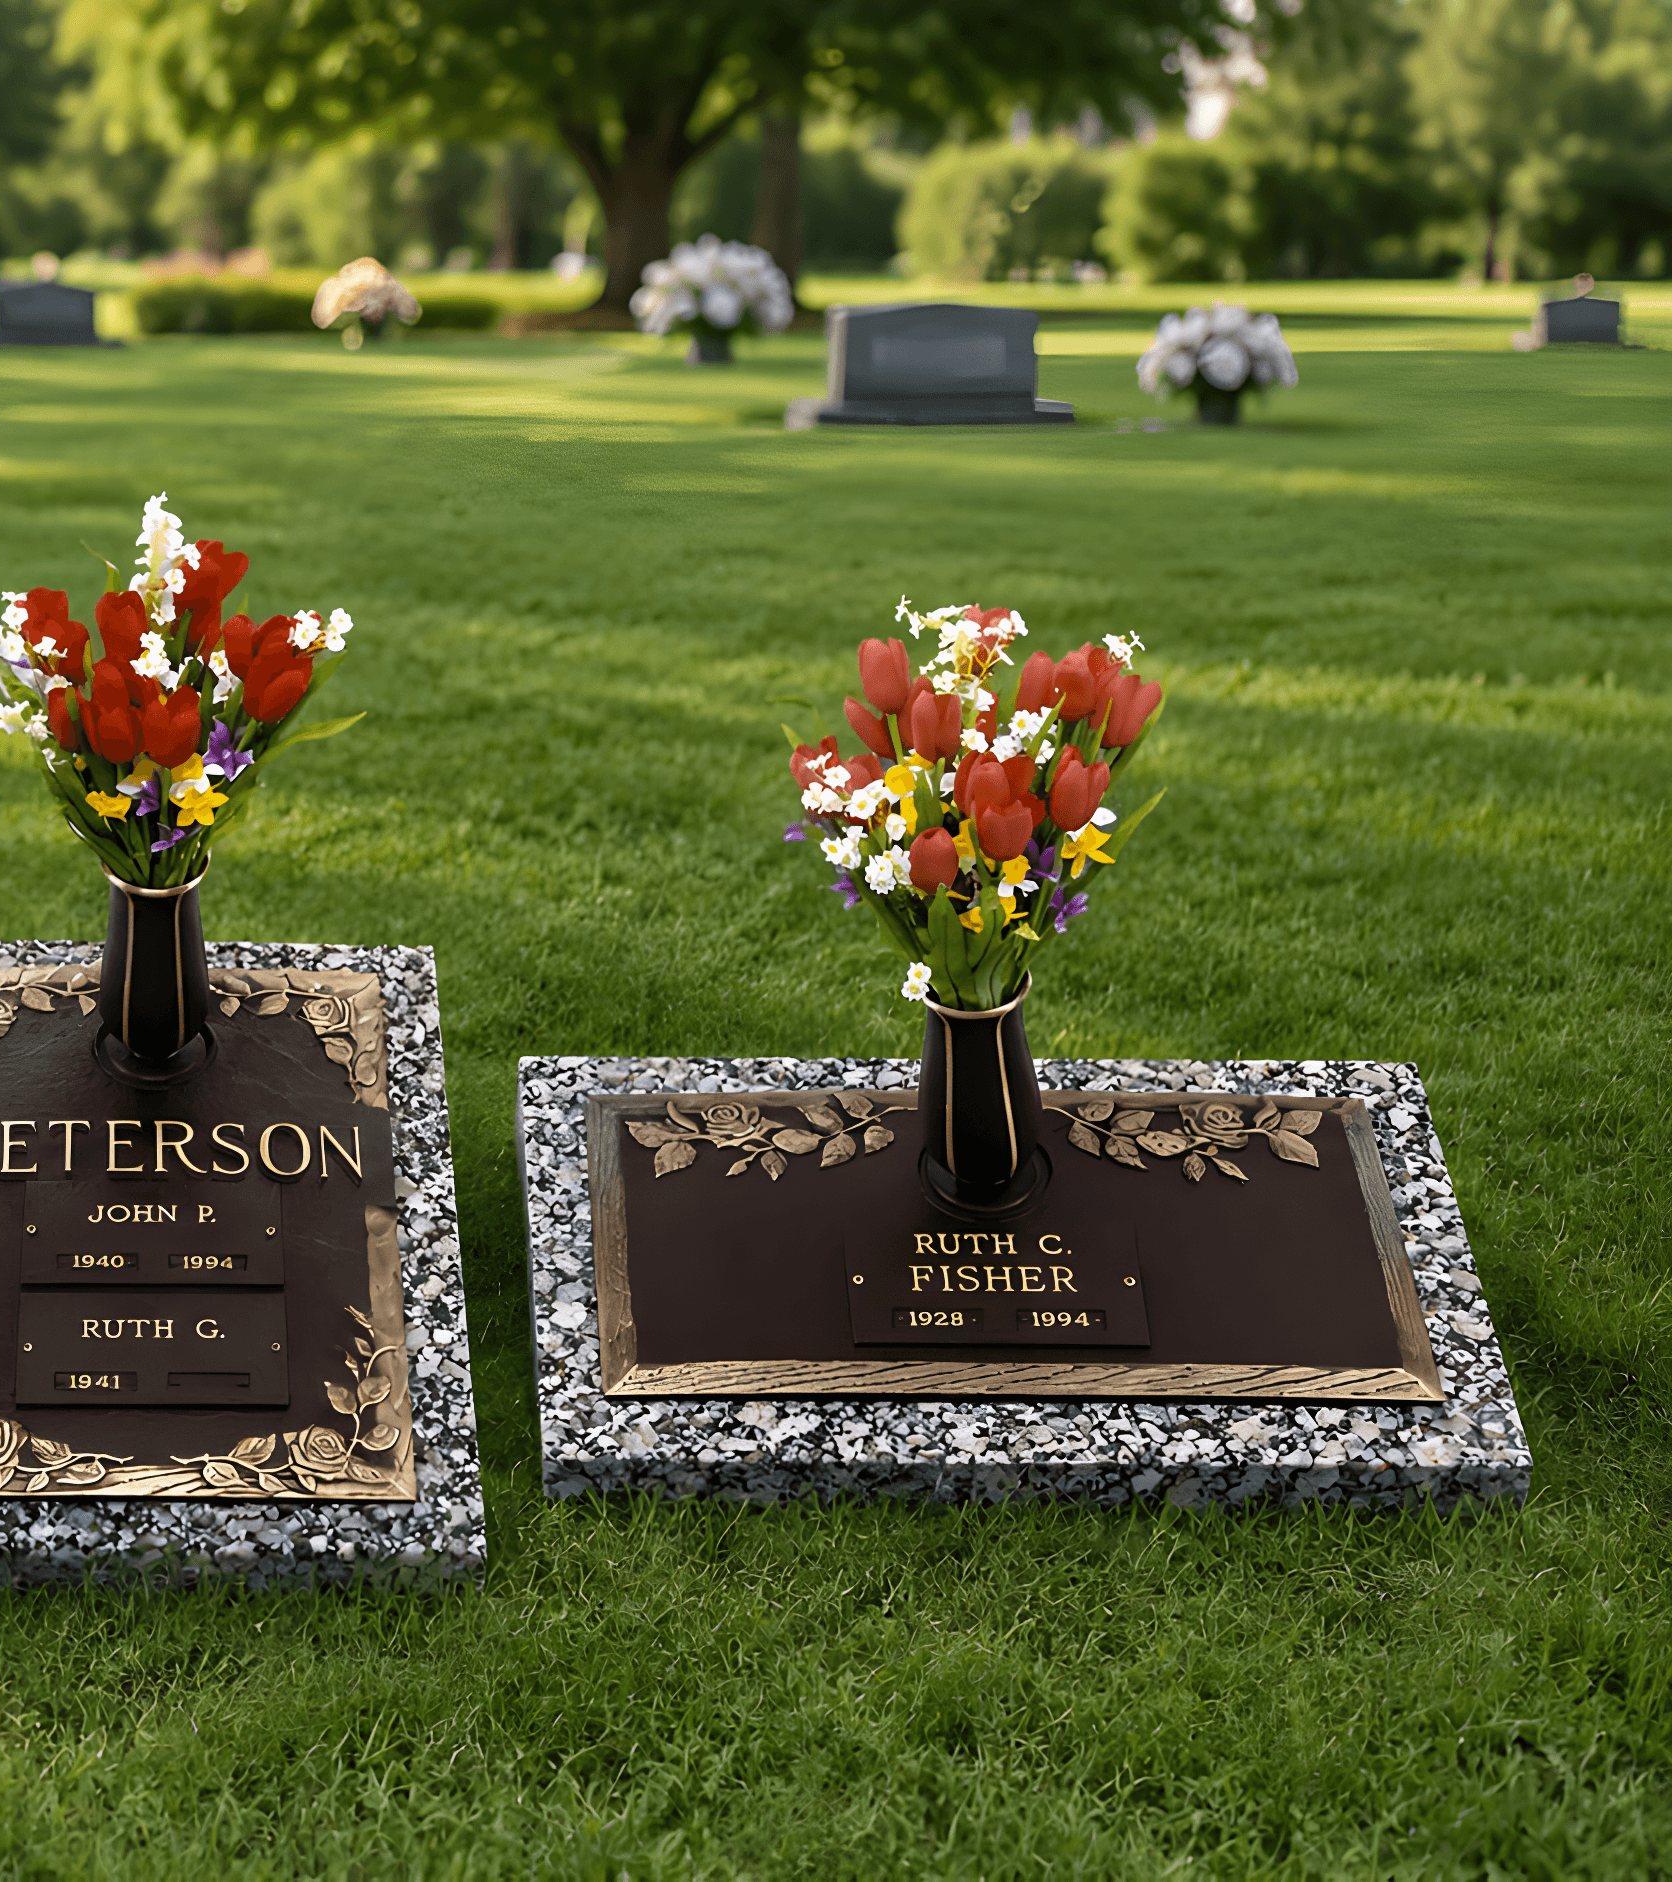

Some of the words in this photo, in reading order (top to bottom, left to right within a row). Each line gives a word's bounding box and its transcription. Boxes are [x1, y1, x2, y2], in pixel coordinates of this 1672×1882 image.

[87, 1204, 178, 1224] JOHN
[197, 1204, 217, 1224] P.
[913, 1232, 1018, 1255] RUTH
[1038, 1234, 1072, 1255] C.
[72, 1254, 124, 1269] 1940
[183, 1255, 233, 1270] 1994
[908, 1265, 1078, 1293] FISHER
[81, 1319, 174, 1339] RUTH
[195, 1318, 226, 1339] G.
[909, 1310, 964, 1327] 1928
[1032, 1311, 1090, 1327] 1994
[68, 1374, 120, 1390] 1941
